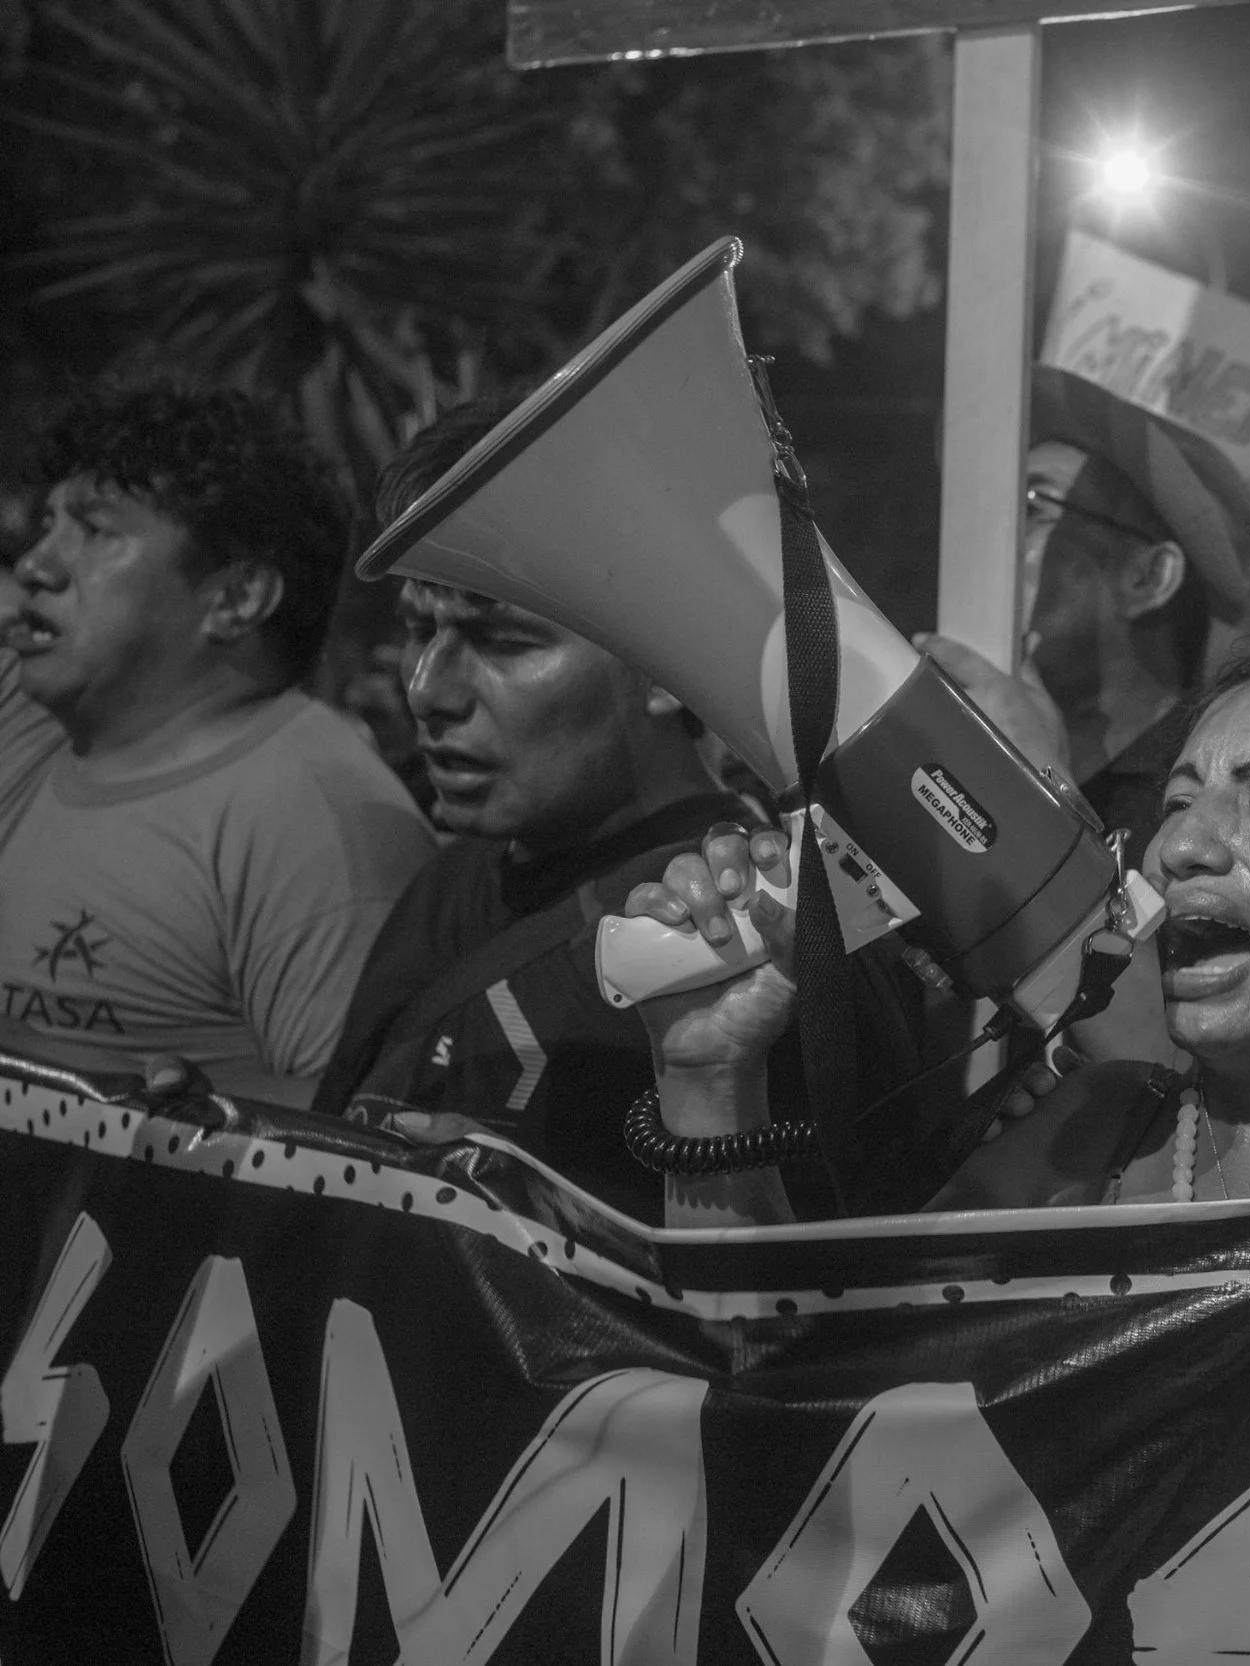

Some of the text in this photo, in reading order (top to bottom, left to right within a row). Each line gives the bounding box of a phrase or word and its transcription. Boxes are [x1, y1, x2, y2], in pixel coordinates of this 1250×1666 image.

[917, 784, 976, 846] MEGAPHONE
[846, 842, 859, 857] ON
[865, 863, 882, 879] OFF
[3, 984, 126, 1034] TASA
